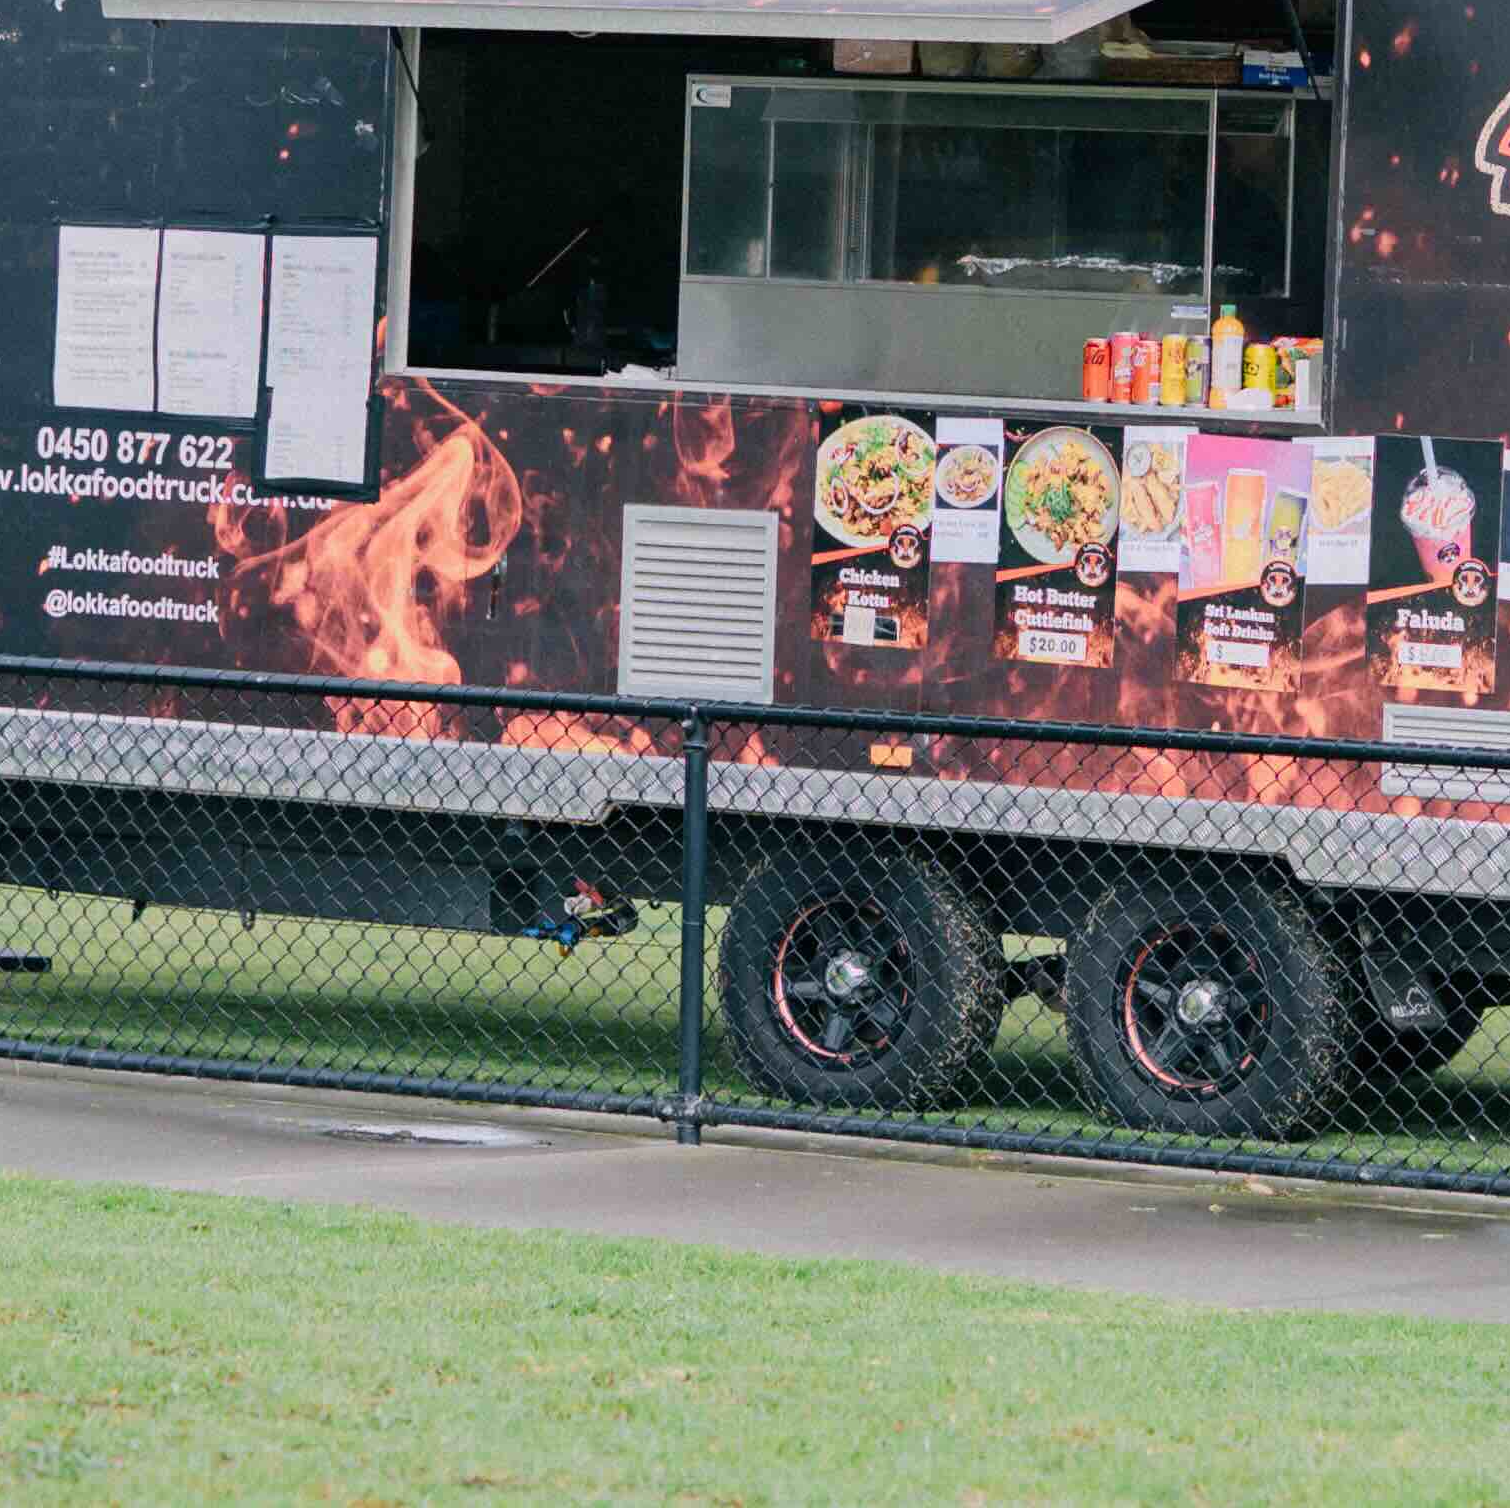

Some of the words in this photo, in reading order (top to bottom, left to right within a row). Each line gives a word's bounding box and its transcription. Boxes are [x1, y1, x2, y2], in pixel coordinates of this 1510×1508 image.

[37, 426, 108, 463] 0450
[117, 430, 171, 466] 877
[178, 434, 233, 471] 622
[47, 545, 220, 580] #Lokkafoodtruck
[838, 567, 900, 588] Chicken
[44, 589, 220, 624] @lokkafoodtruck
[848, 589, 891, 608] Kottu
[1013, 585, 1043, 604] Hot
[1046, 587, 1097, 609] Butter
[1204, 603, 1225, 619] Sri
[1226, 605, 1275, 624] Lankan
[1395, 608, 1466, 633] Faluda
[1203, 621, 1231, 638] Soft
[1231, 624, 1275, 642] Drinks
[1029, 636, 1077, 655] $20.00
